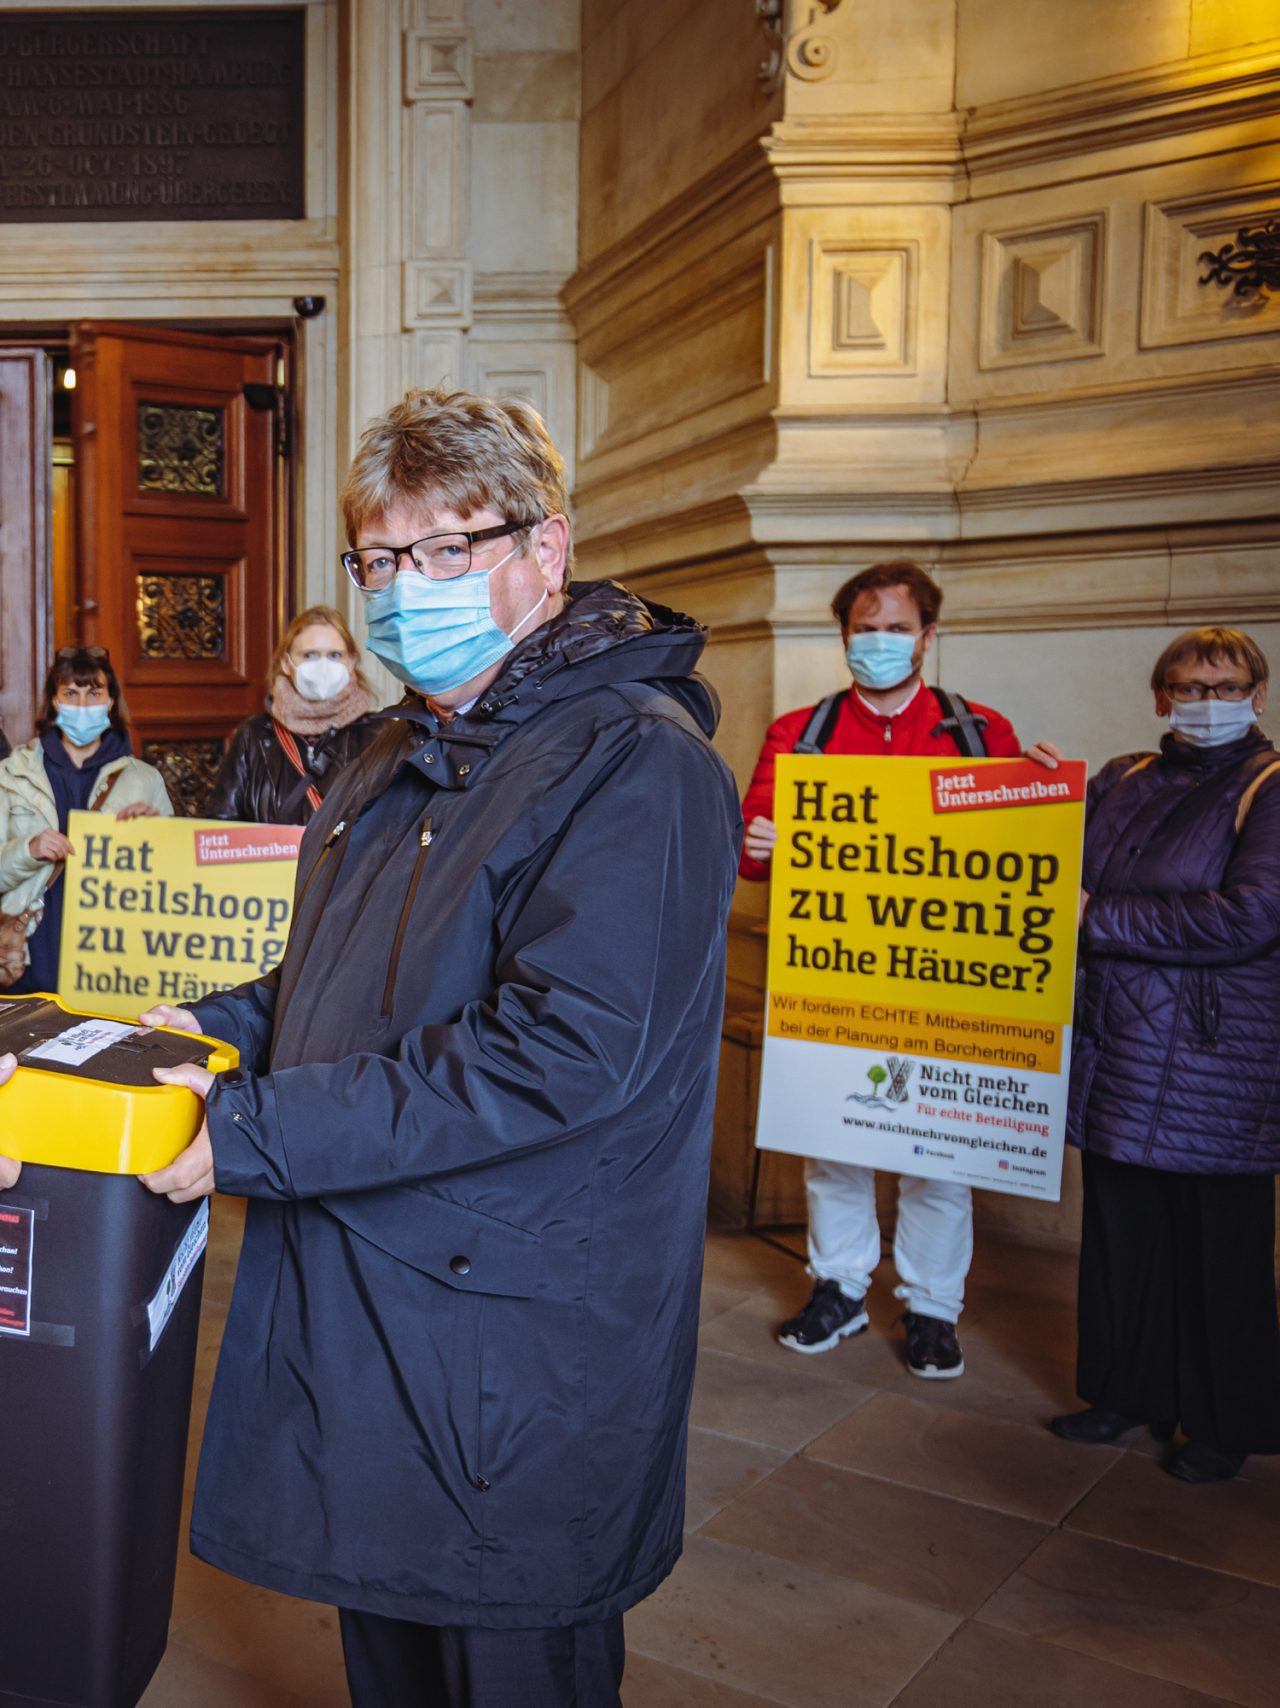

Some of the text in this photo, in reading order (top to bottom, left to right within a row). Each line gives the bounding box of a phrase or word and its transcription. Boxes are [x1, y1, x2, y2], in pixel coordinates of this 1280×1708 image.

[791, 780, 880, 824] Hat
[936, 772, 977, 791] Jetzt
[937, 780, 1070, 808] Unterschreiben
[81, 833, 155, 873] Hat
[199, 833, 229, 848] Jetzt
[199, 842, 298, 862] Unterschreiben
[790, 831, 1060, 896] Steilshoop
[79, 876, 290, 932] Steilshoop
[788, 888, 1055, 955] zu wenig
[77, 924, 286, 976] zu wenig
[786, 934, 1053, 994] hohe Häuser?
[74, 962, 150, 994] hohe
[772, 995, 1056, 1045] Wir fordern ECHTE Mitbestimmung
[780, 1019, 1043, 1067] bei der Planung am Borchertring.
[919, 1084, 1051, 1117] vom Gleichen
[920, 1064, 1030, 1096] Nicht mehr
[842, 1115, 1048, 1159] www.nichtmehrvomgleichen.de
[917, 1103, 1050, 1137] Für echte Beteiligung
